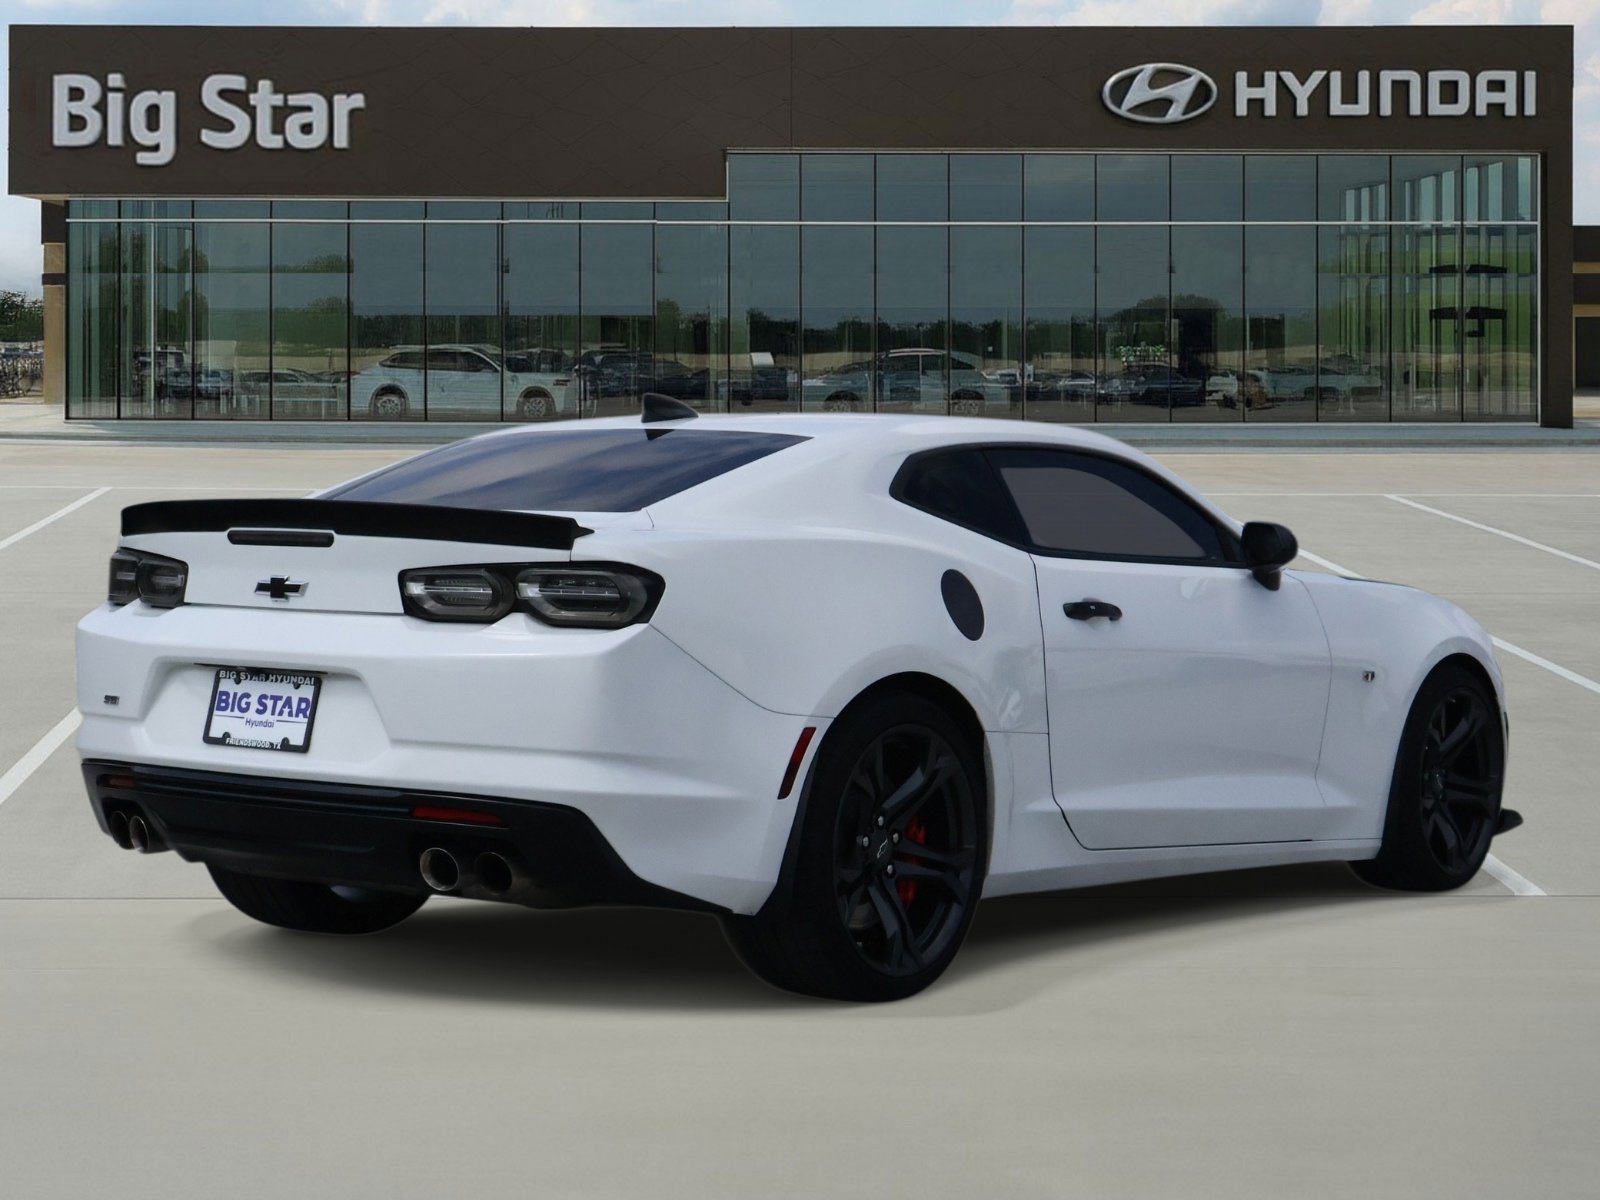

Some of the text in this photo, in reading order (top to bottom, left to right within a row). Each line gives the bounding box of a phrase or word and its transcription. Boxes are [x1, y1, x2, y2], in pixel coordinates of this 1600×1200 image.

[1235, 70, 1537, 117] HYUNDAI
[52, 73, 366, 166] Big Star
[219, 670, 237, 679] BIG
[268, 674, 315, 685] HYUNDAI
[215, 690, 311, 718] BIG STAR
[245, 718, 275, 728] Hyundai
[273, 741, 281, 750] TX
